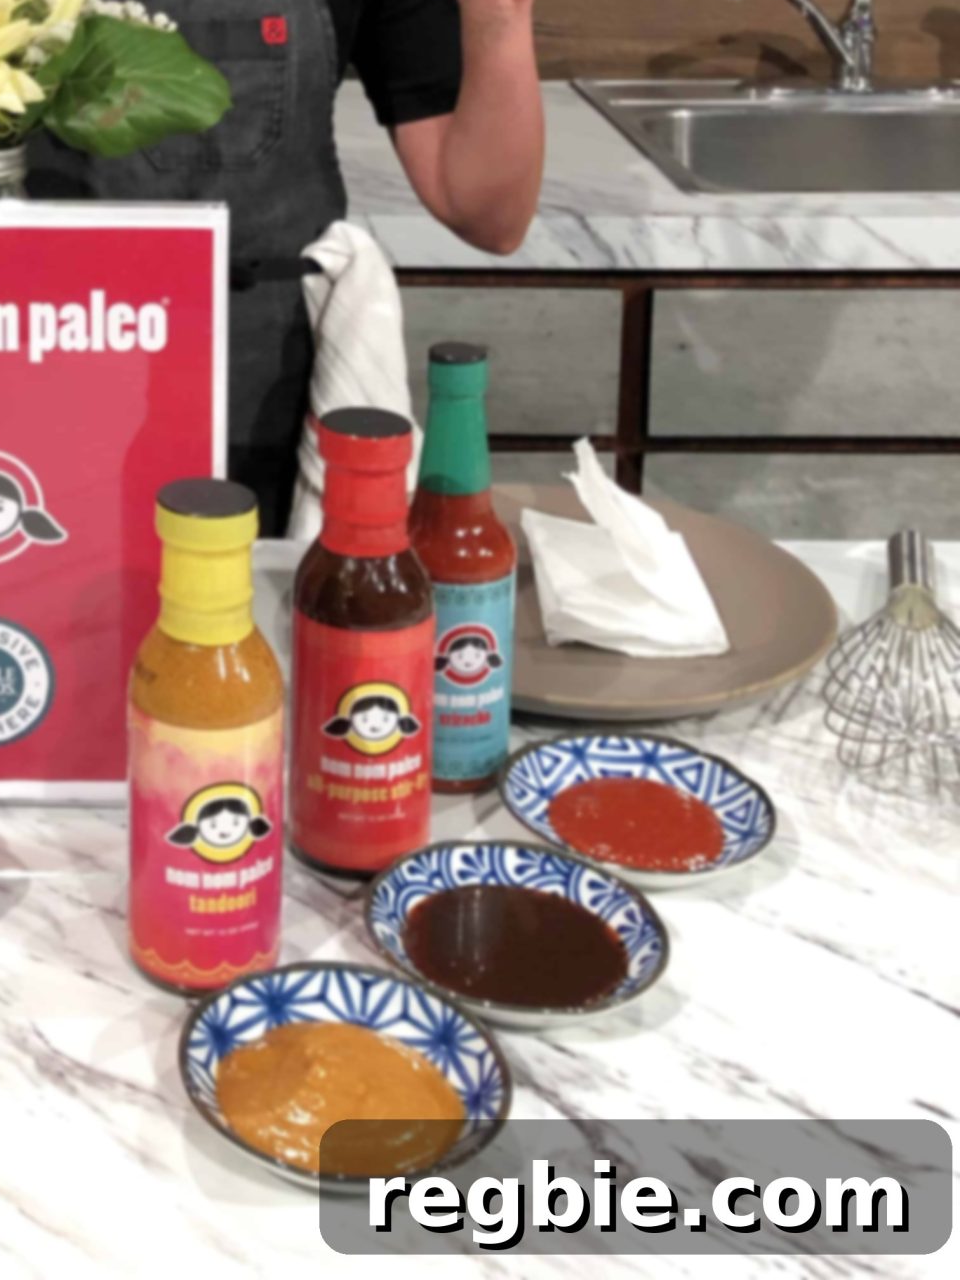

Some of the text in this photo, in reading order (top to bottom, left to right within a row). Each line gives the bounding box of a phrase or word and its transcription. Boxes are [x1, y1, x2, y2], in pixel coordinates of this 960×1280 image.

[28, 289, 168, 363] paleo
[165, 865, 200, 889] nom
[202, 871, 237, 889] nom
[189, 886, 257, 913] tandoori
